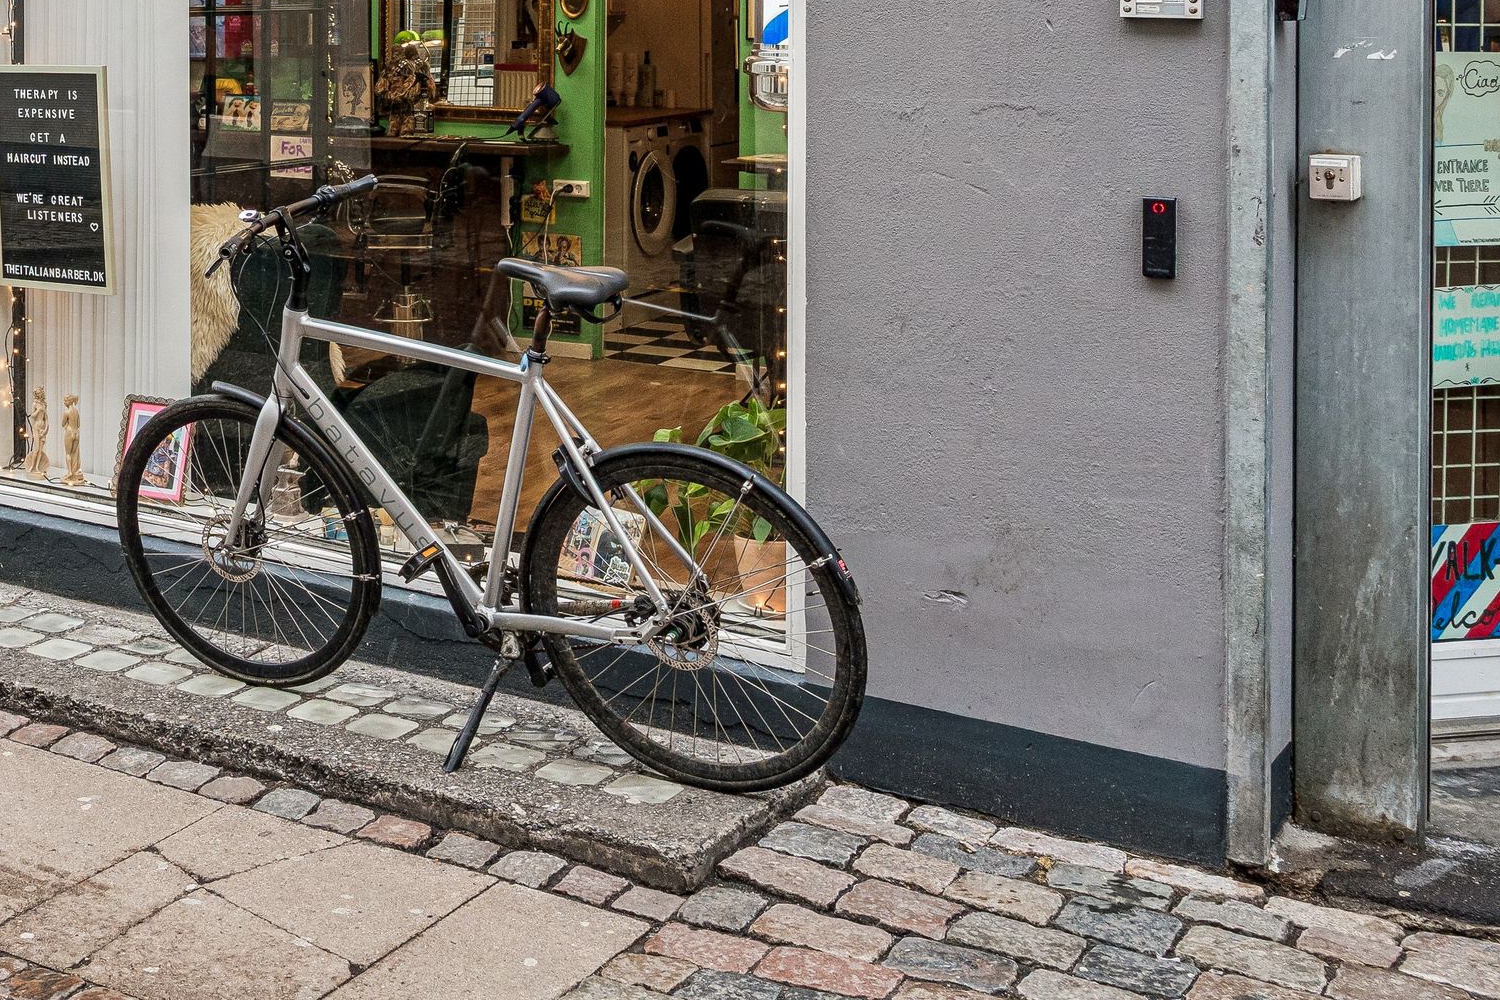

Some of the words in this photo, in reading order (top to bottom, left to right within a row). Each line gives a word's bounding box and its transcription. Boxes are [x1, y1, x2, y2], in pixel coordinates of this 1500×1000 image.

[13, 89, 58, 100] THERAPY
[68, 90, 78, 100] IS
[18, 108, 75, 119] EXPENSIVE
[30, 133, 50, 142] GET
[59, 133, 66, 143] A
[281, 141, 306, 156] FOR
[7, 153, 47, 164] HAIRCUT
[53, 155, 90, 166] INSTEAD
[1437, 159, 1488, 174] ENTRANCE
[1433, 180, 1454, 192] VER
[1456, 178, 1489, 192] THERE
[16, 192, 43, 205] WE'RE
[51, 195, 84, 206] GREAT
[27, 209, 83, 223] LISTENERS
[4, 263, 105, 282] THEITALIANBARBER.DK
[307, 398, 429, 551] batavus
